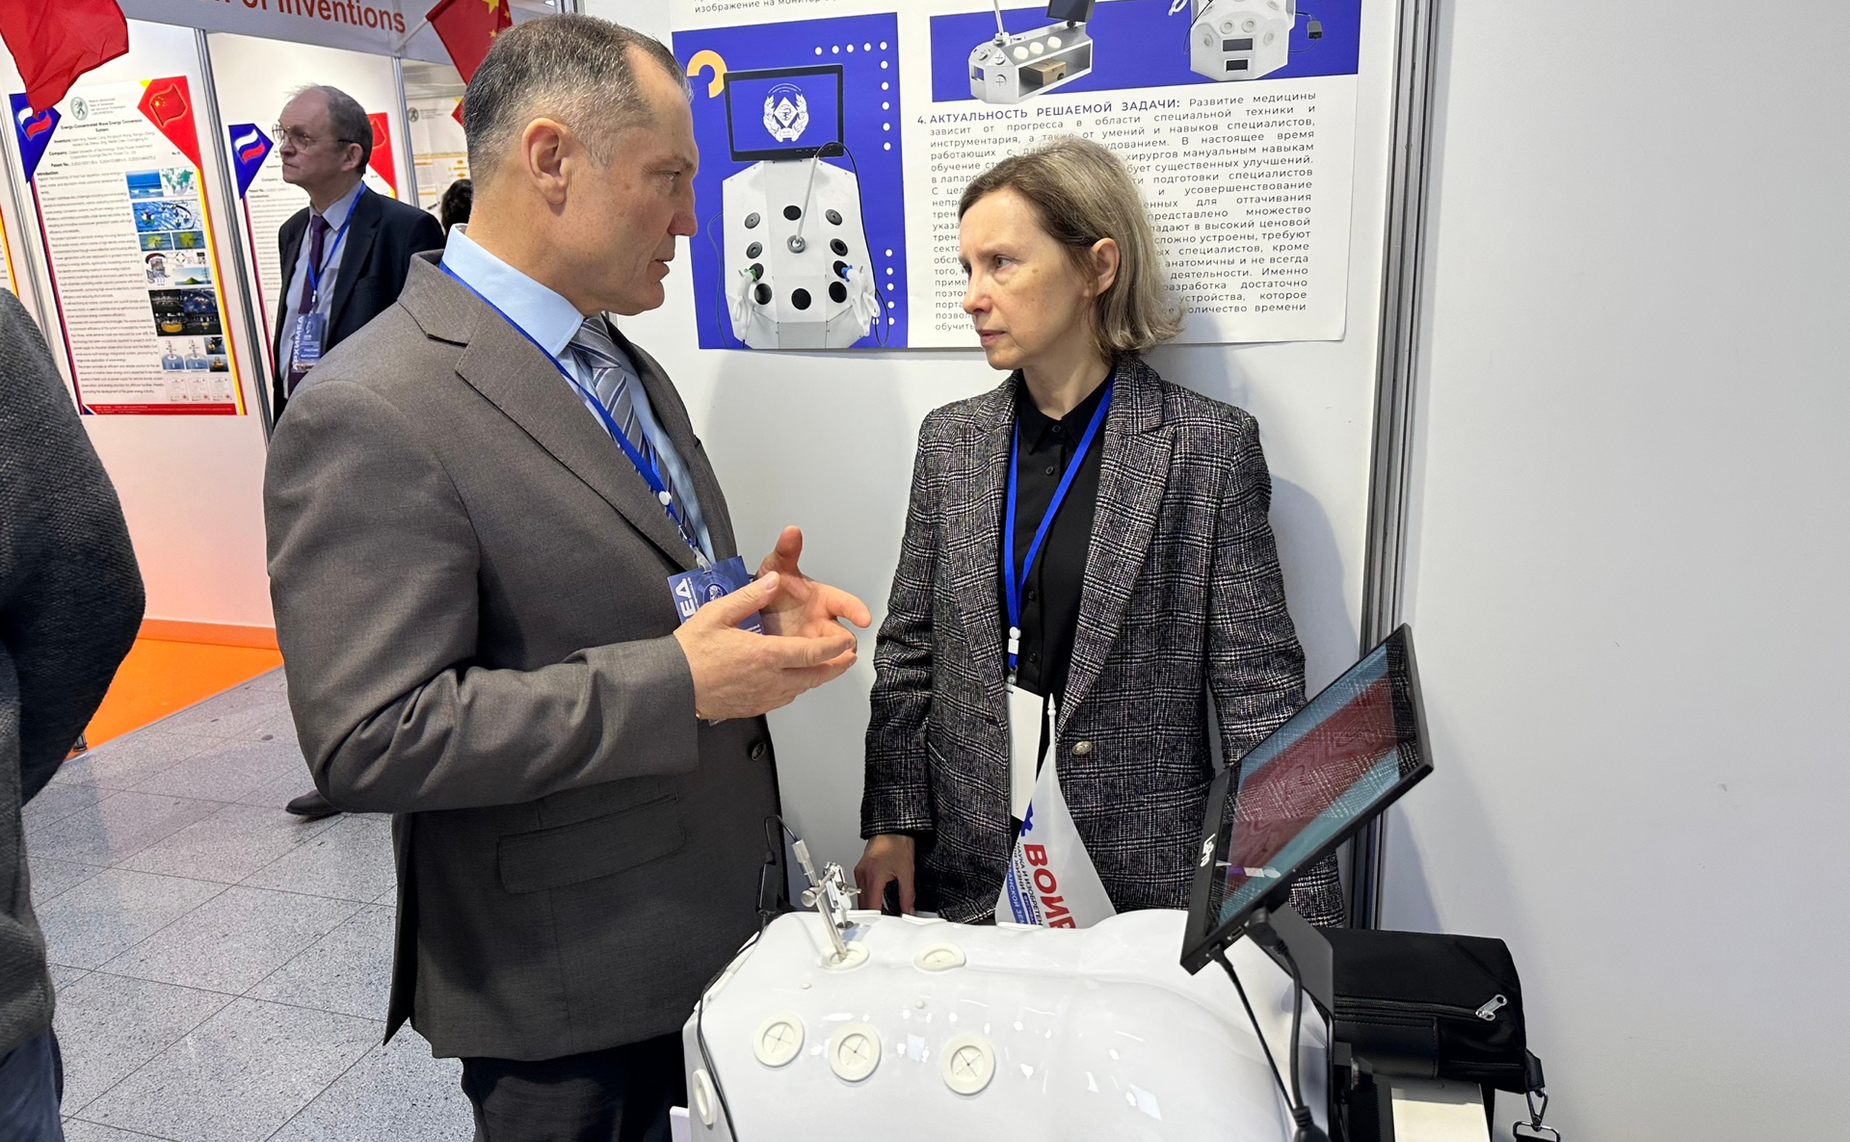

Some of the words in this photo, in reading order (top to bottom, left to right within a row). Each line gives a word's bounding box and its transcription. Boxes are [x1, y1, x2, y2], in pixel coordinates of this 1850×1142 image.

[695, 1, 760, 13] изображение
[918, 116, 926, 124] 4.
[930, 109, 1027, 123] АКТУАЛЬНОСТЬ
[1037, 102, 1111, 116] РЕШАЕМОЙ
[1122, 99, 1179, 111] ЗАДАЧИ:
[1190, 97, 1243, 106] Развитие
[1253, 93, 1315, 103] медицины
[930, 127, 970, 135] зависит
[1007, 122, 1063, 132] прогресса
[1095, 117, 1140, 125] области
[1154, 109, 1231, 121] специальной
[1246, 107, 1293, 115] техники
[931, 137, 1020, 148] инструментария,
[1043, 132, 1074, 141] также
[1083, 131, 1094, 139] от
[1102, 127, 1144, 139] умений
[1170, 124, 1218, 133] навыков
[1227, 119, 1314, 130] специалистов,
[931, 151, 995, 161] работающих
[1182, 137, 1188, 145] В
[1202, 134, 1264, 143] настоящее
[1278, 131, 1314, 141] время
[931, 163, 980, 173] обучение
[1125, 151, 1178, 161] хирургов
[1184, 148, 1256, 158] мануальным
[1262, 144, 1313, 152] навыкам
[1155, 161, 1238, 173] существенных
[1243, 155, 1312, 168] улучшений.
[1154, 174, 1218, 184] подготовки
[1229, 169, 1312, 179] специалистов
[1185, 182, 1312, 196] усовершенствование
[1196, 199, 1216, 207] для
[1237, 194, 1311, 204] оттачивания
[1246, 207, 1311, 215] множество
[1205, 220, 1254, 230] высокий
[1260, 218, 1310, 228] ценовой
[1154, 236, 1196, 245] сложно
[1200, 234, 1257, 244] устроены,
[1262, 230, 1310, 241] требуют
[1179, 245, 1264, 258] специалистов,
[1273, 244, 1309, 252] кроме
[1165, 259, 1234, 268] анатомичны
[1170, 269, 1253, 280] деятельности.
[1241, 280, 1307, 289] достаточно
[1179, 292, 1246, 304] устройства,
[1260, 292, 1306, 300] которое
[1188, 305, 1248, 315] оличество
[1255, 304, 1306, 313] времени
